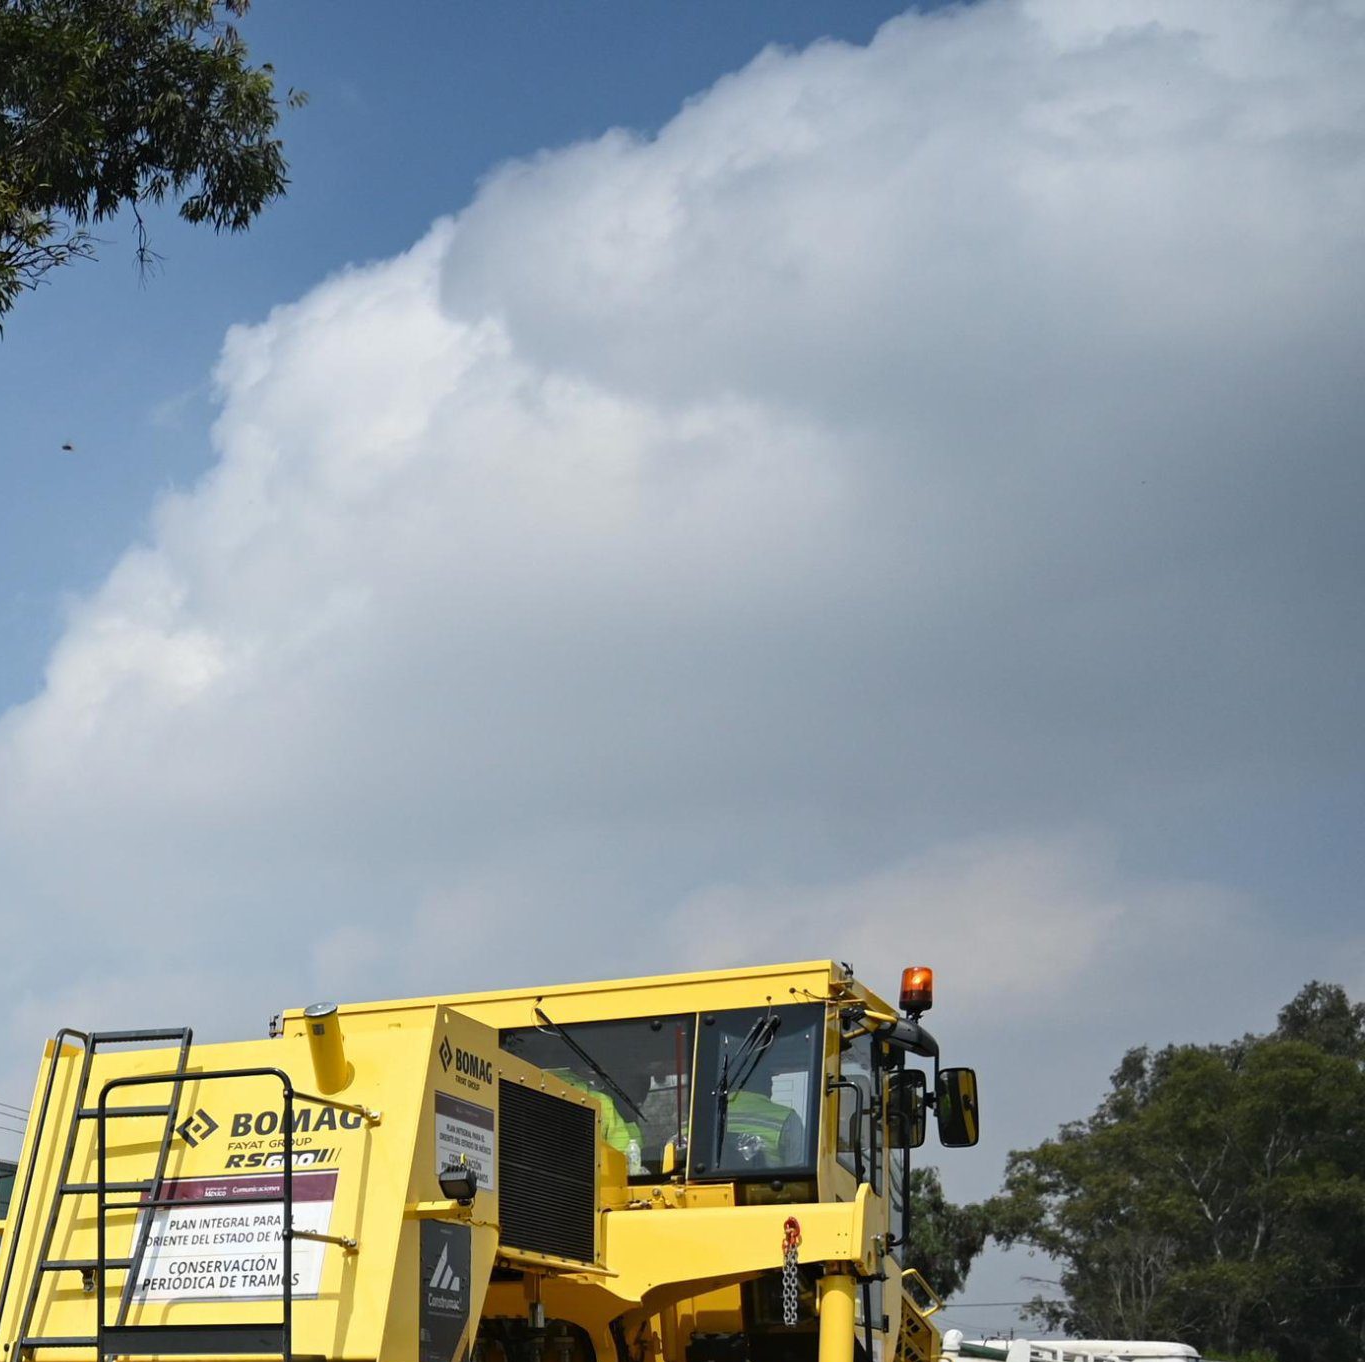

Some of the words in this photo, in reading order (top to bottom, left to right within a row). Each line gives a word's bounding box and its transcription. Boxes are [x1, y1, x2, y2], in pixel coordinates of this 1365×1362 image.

[455, 1047, 493, 1086] BOMAG
[230, 1104, 363, 1138] BOMAG
[227, 1140, 265, 1151] FAYAT
[268, 1137, 312, 1149] GRUP
[232, 1184, 282, 1194] Comunicaciones
[169, 1218, 197, 1231] PLAN
[199, 1215, 250, 1230] INTEGRAL
[253, 1214, 282, 1227] PARA
[193, 1233, 210, 1246] DEL
[213, 1231, 255, 1245] ESTADO
[257, 1230, 271, 1243] DE
[169, 1254, 278, 1275] CONSERVACIÓN
[142, 1272, 215, 1292] PERIÓDICA
[219, 1274, 237, 1290] DE
[241, 1272, 300, 1288] TRAMS
